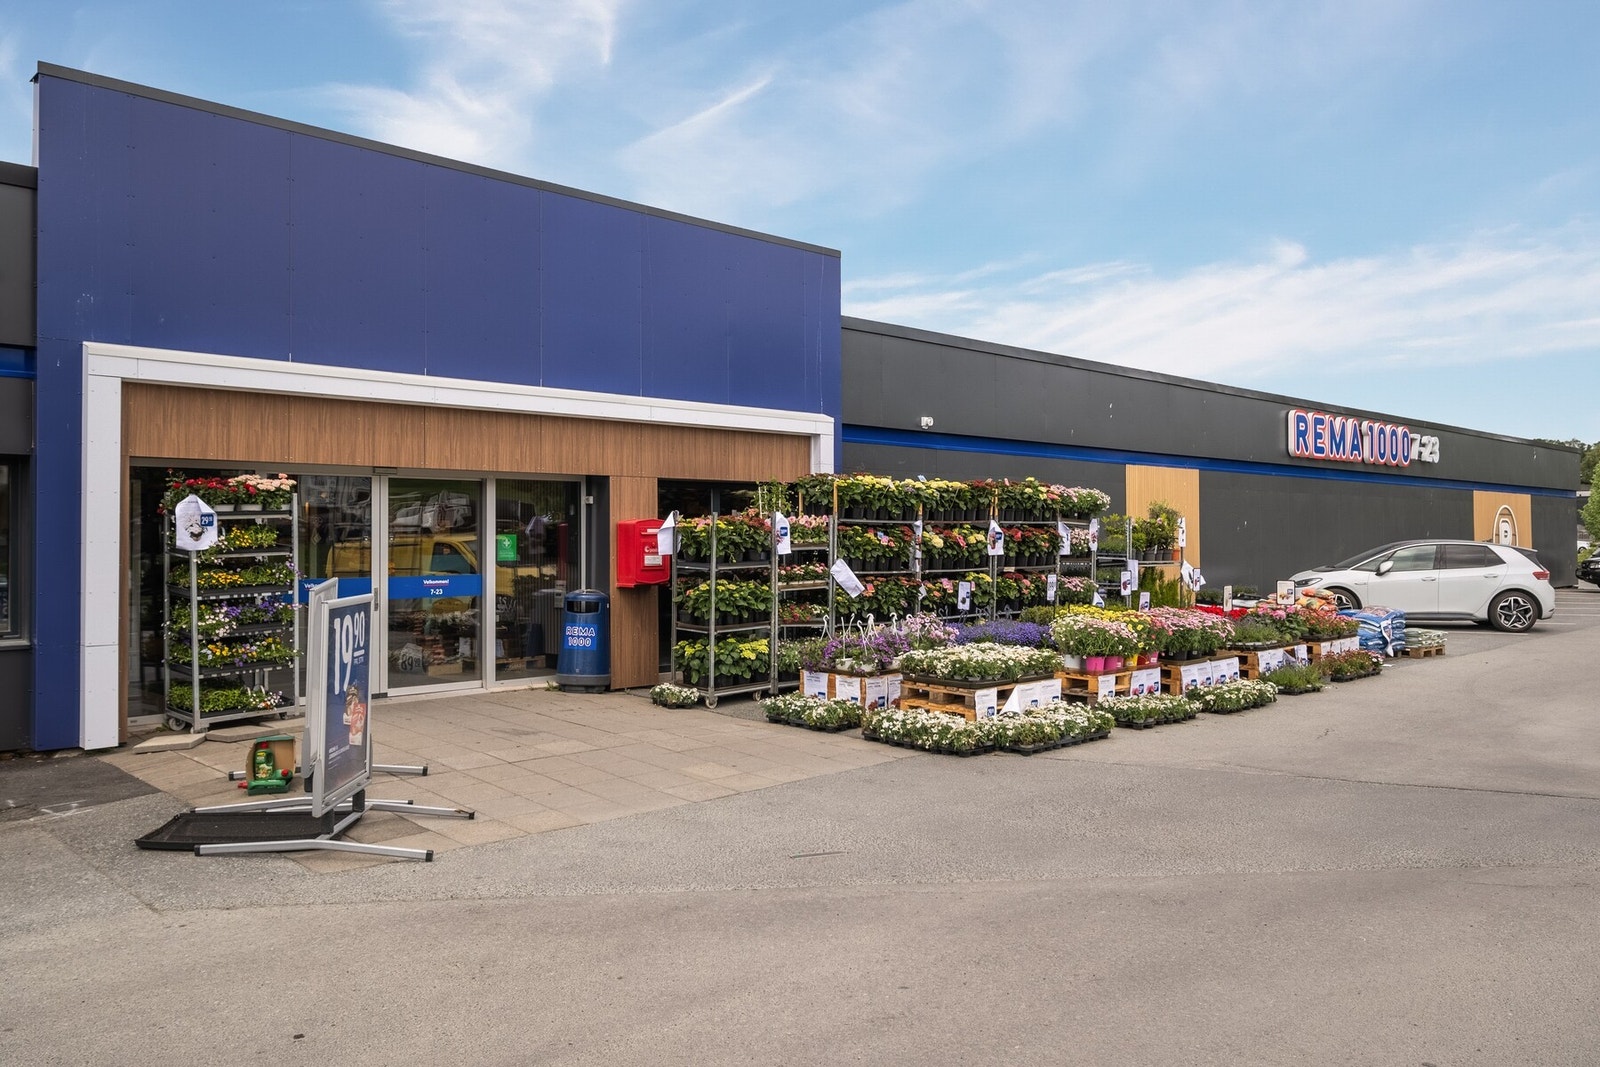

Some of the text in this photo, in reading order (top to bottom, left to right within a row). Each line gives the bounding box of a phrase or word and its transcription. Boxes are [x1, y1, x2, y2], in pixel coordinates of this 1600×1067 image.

[1288, 409, 1440, 467] REMA 1000 7-23
[565, 626, 596, 637] REMA
[568, 637, 592, 647] 1000
